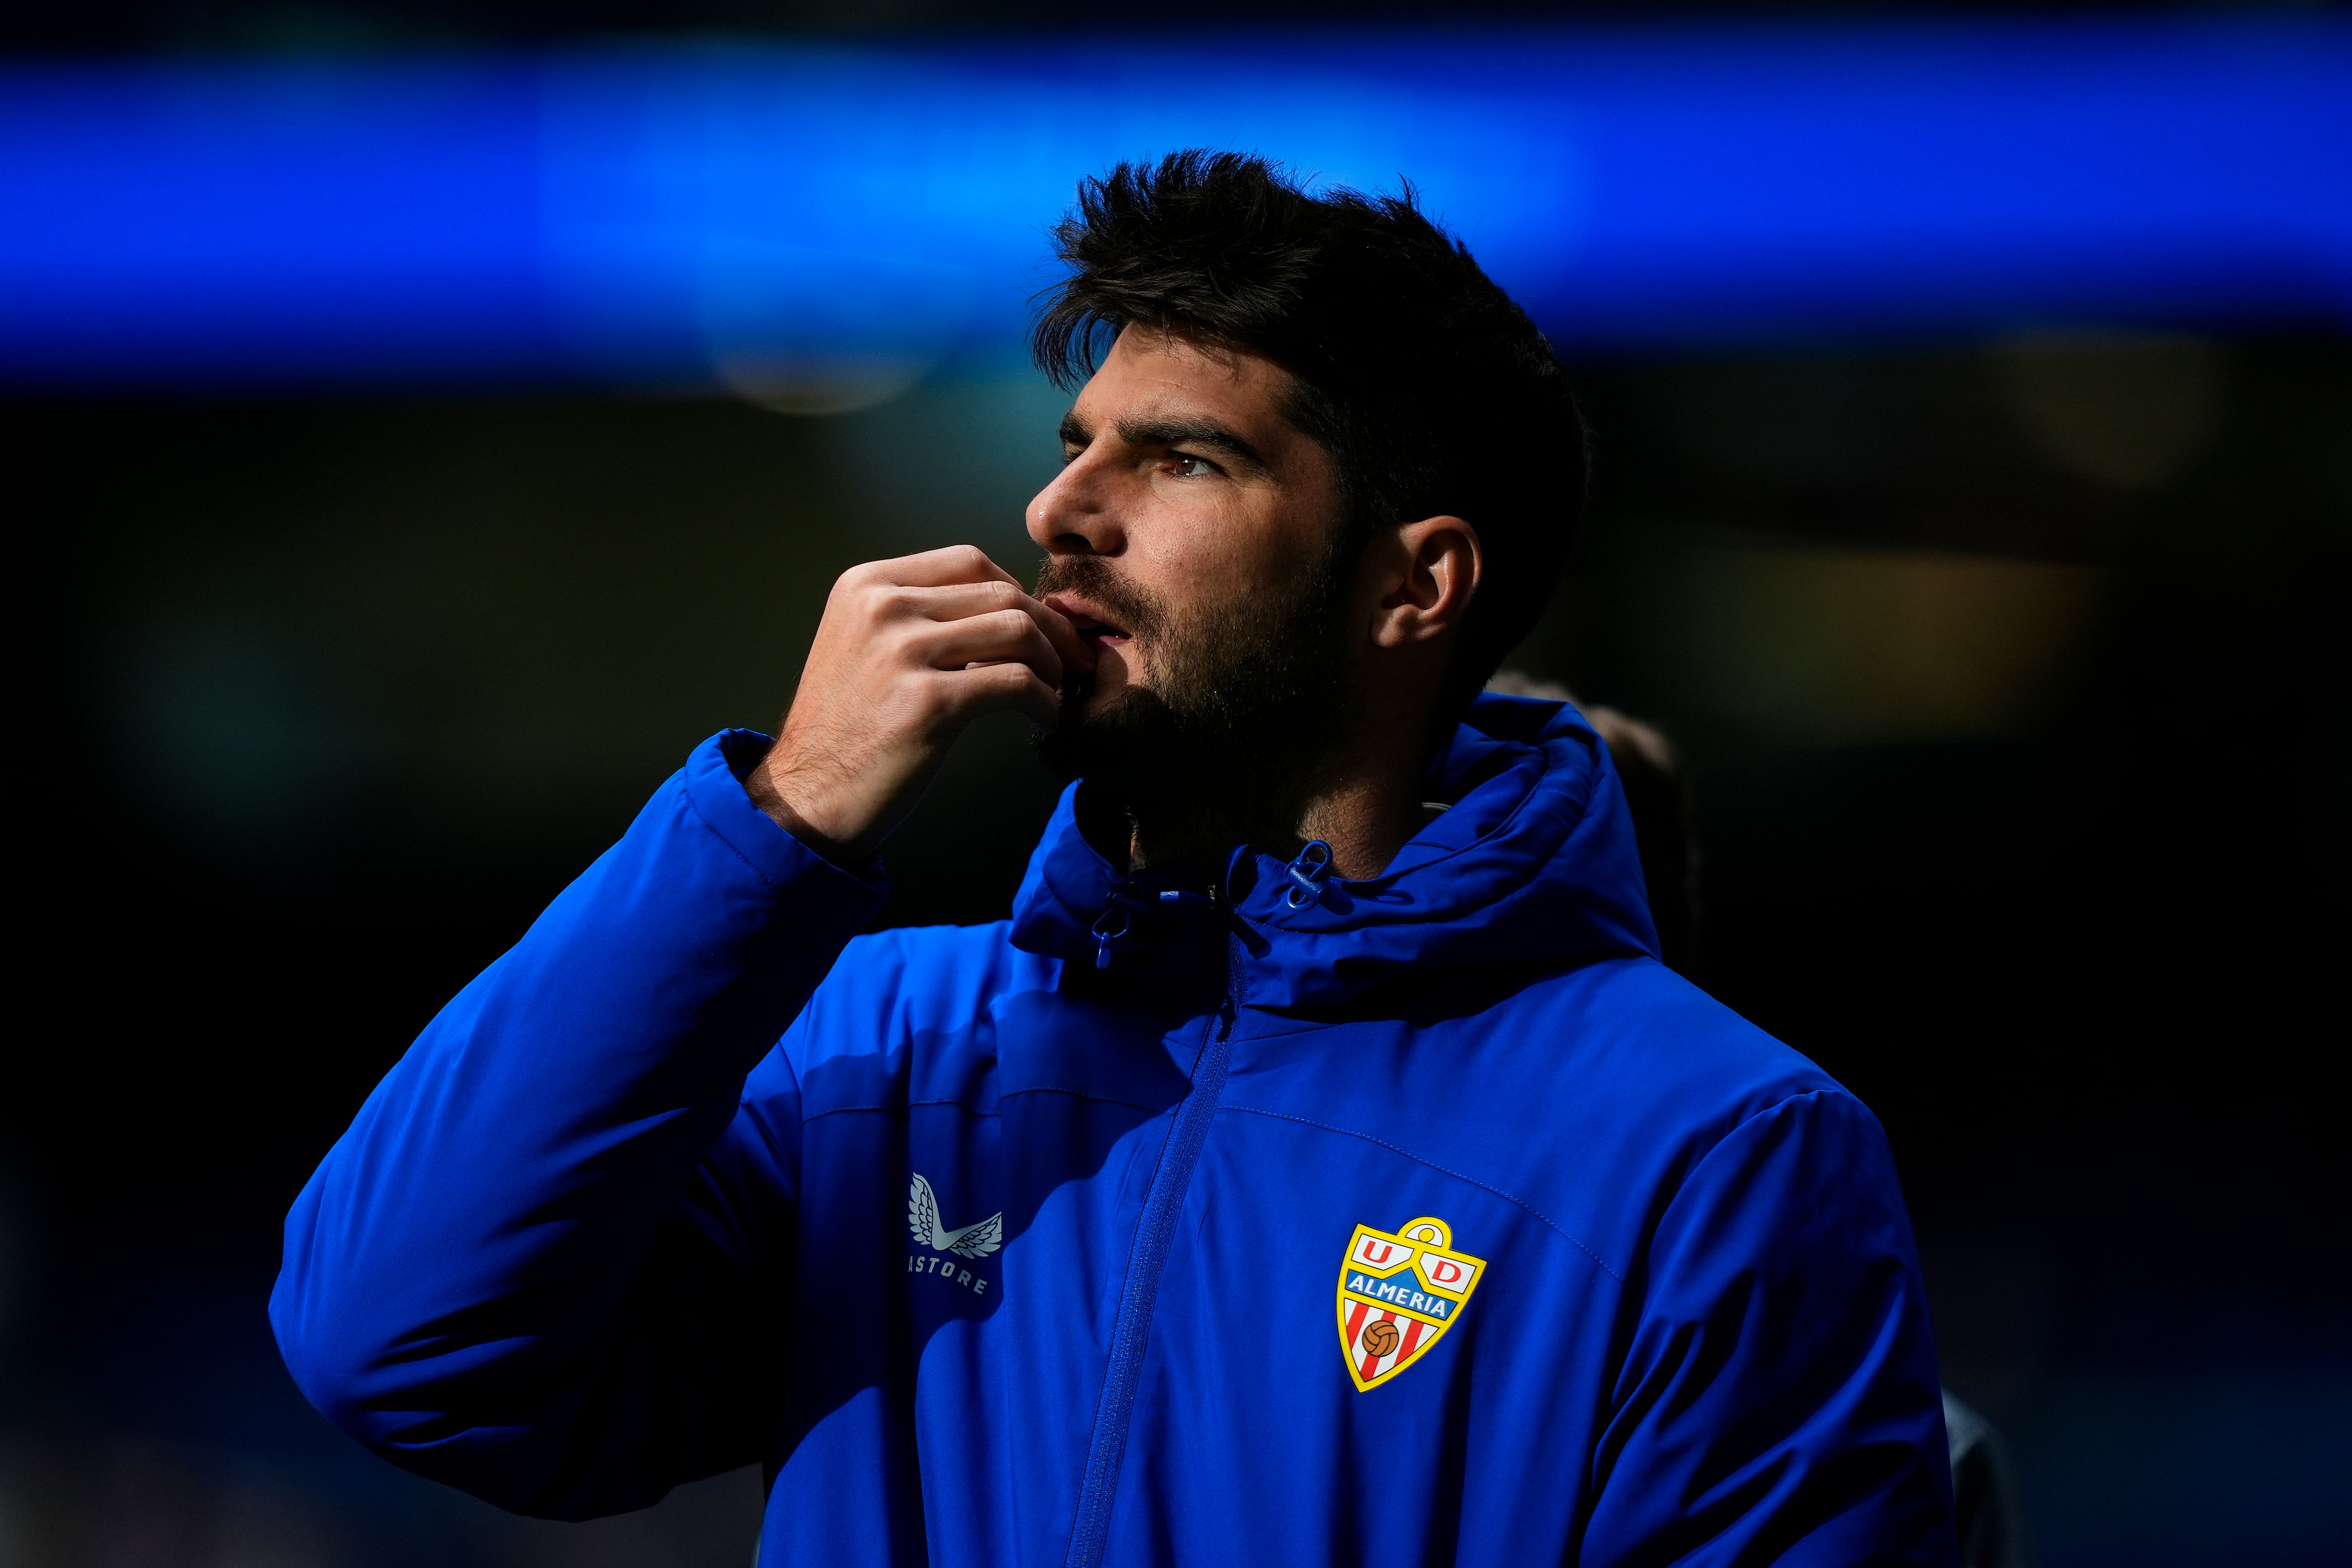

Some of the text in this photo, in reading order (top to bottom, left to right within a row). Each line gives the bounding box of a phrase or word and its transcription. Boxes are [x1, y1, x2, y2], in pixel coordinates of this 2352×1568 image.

[908, 1256, 987, 1294] ASTORE
[1363, 1241, 1461, 1283] U D
[1348, 1275, 1446, 1317] ALMERIA
